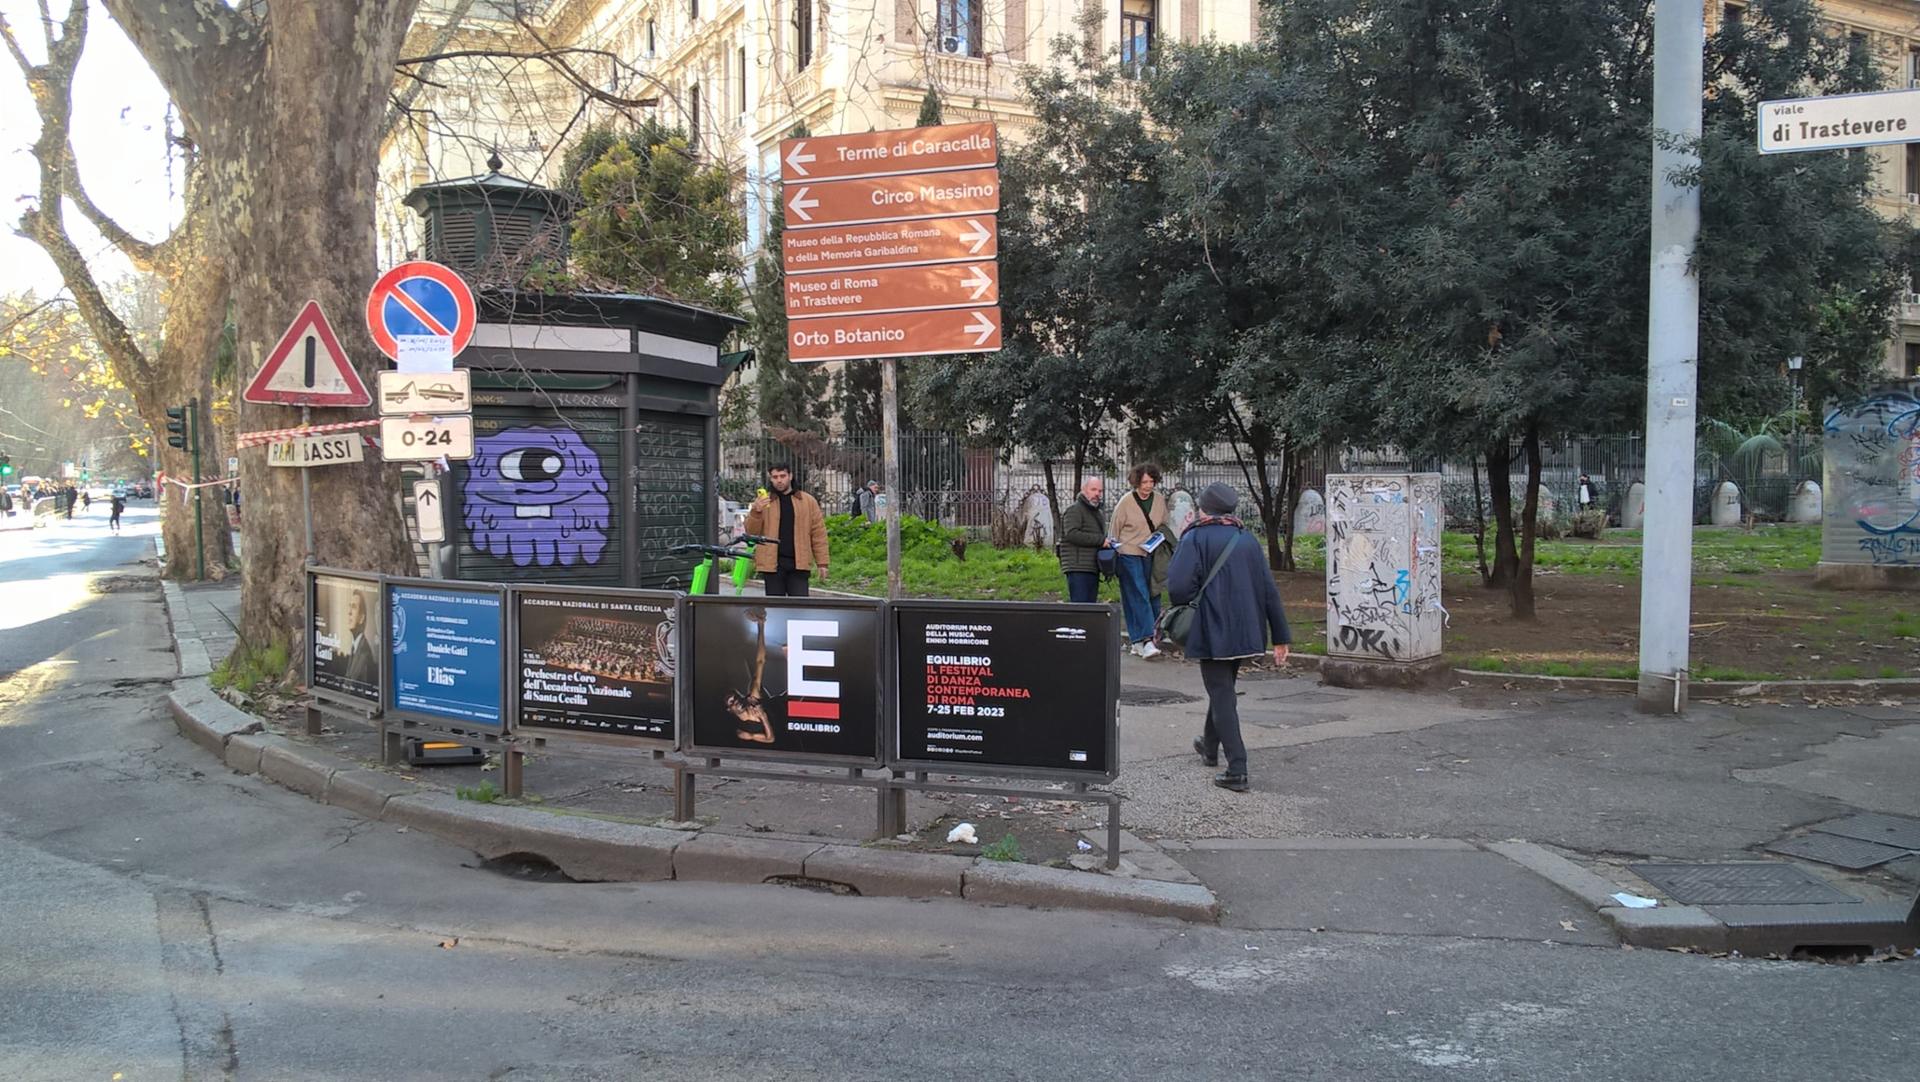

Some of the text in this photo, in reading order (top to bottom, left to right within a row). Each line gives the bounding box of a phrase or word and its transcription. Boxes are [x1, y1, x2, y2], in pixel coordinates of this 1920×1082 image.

[1774, 105, 1804, 115] viale
[1773, 118, 1907, 142] di Trastevere
[837, 134, 991, 162] Terme di Caracalla
[871, 183, 993, 206] Circo Massimo
[787, 228, 941, 248] Museo della Repubblica Romana
[796, 251, 818, 262] della
[821, 248, 862, 260] Memoria
[864, 244, 918, 257] Garibaldina
[789, 278, 878, 293] Museo di Roma
[790, 293, 862, 308] in Trastevere
[793, 326, 905, 347] Orto Botanico
[523, 599, 561, 607] ACCADEMIA
[610, 603, 632, 611] SANTA
[787, 620, 840, 698] E
[926, 655, 991, 666] EQUILIBRIO
[427, 667, 455, 686] Elias
[524, 668, 566, 681] Orchestra
[573, 672, 596, 683] Coro
[927, 666, 993, 676] IL FESTIVAL
[927, 675, 981, 686] DI DANZA
[524, 679, 632, 698] dell'Accademia Nazionale
[927, 685, 1031, 698] CONTEMPORANEA
[524, 691, 588, 706] di Santa Cecilia
[927, 695, 975, 705] DI ROMA
[927, 704, 1005, 717] 7-25 FEB 2023
[787, 722, 840, 733] EQUILIBRIO
[927, 732, 983, 741] auditorium.com
